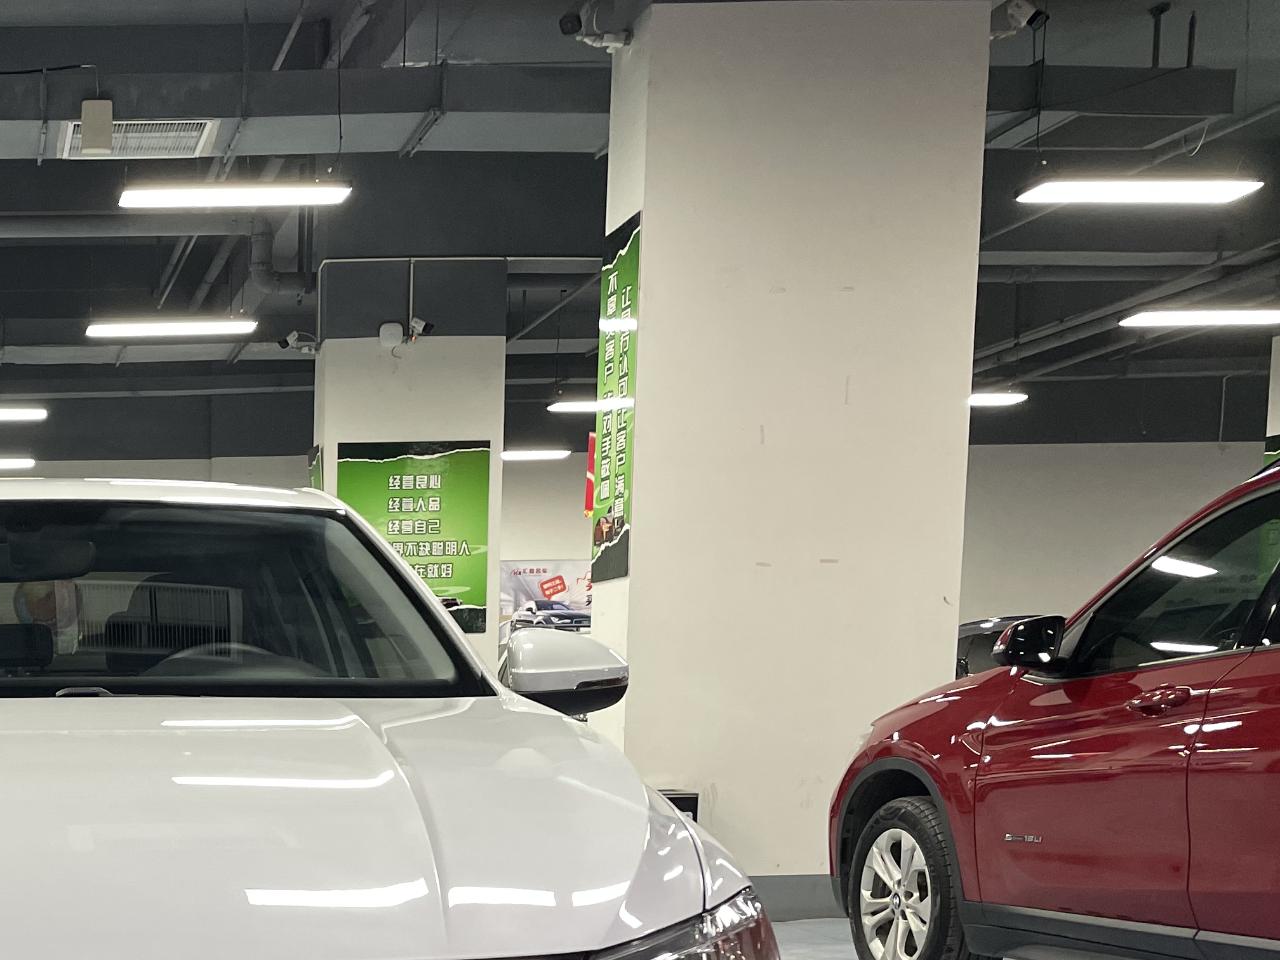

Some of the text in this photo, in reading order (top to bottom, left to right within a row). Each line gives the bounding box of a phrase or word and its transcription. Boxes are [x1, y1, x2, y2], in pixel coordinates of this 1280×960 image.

[388, 474, 441, 490] 经营良心
[388, 497, 441, 512] 经营人品
[387, 519, 441, 535] 经营自己
[409, 563, 453, 578] 在就好
